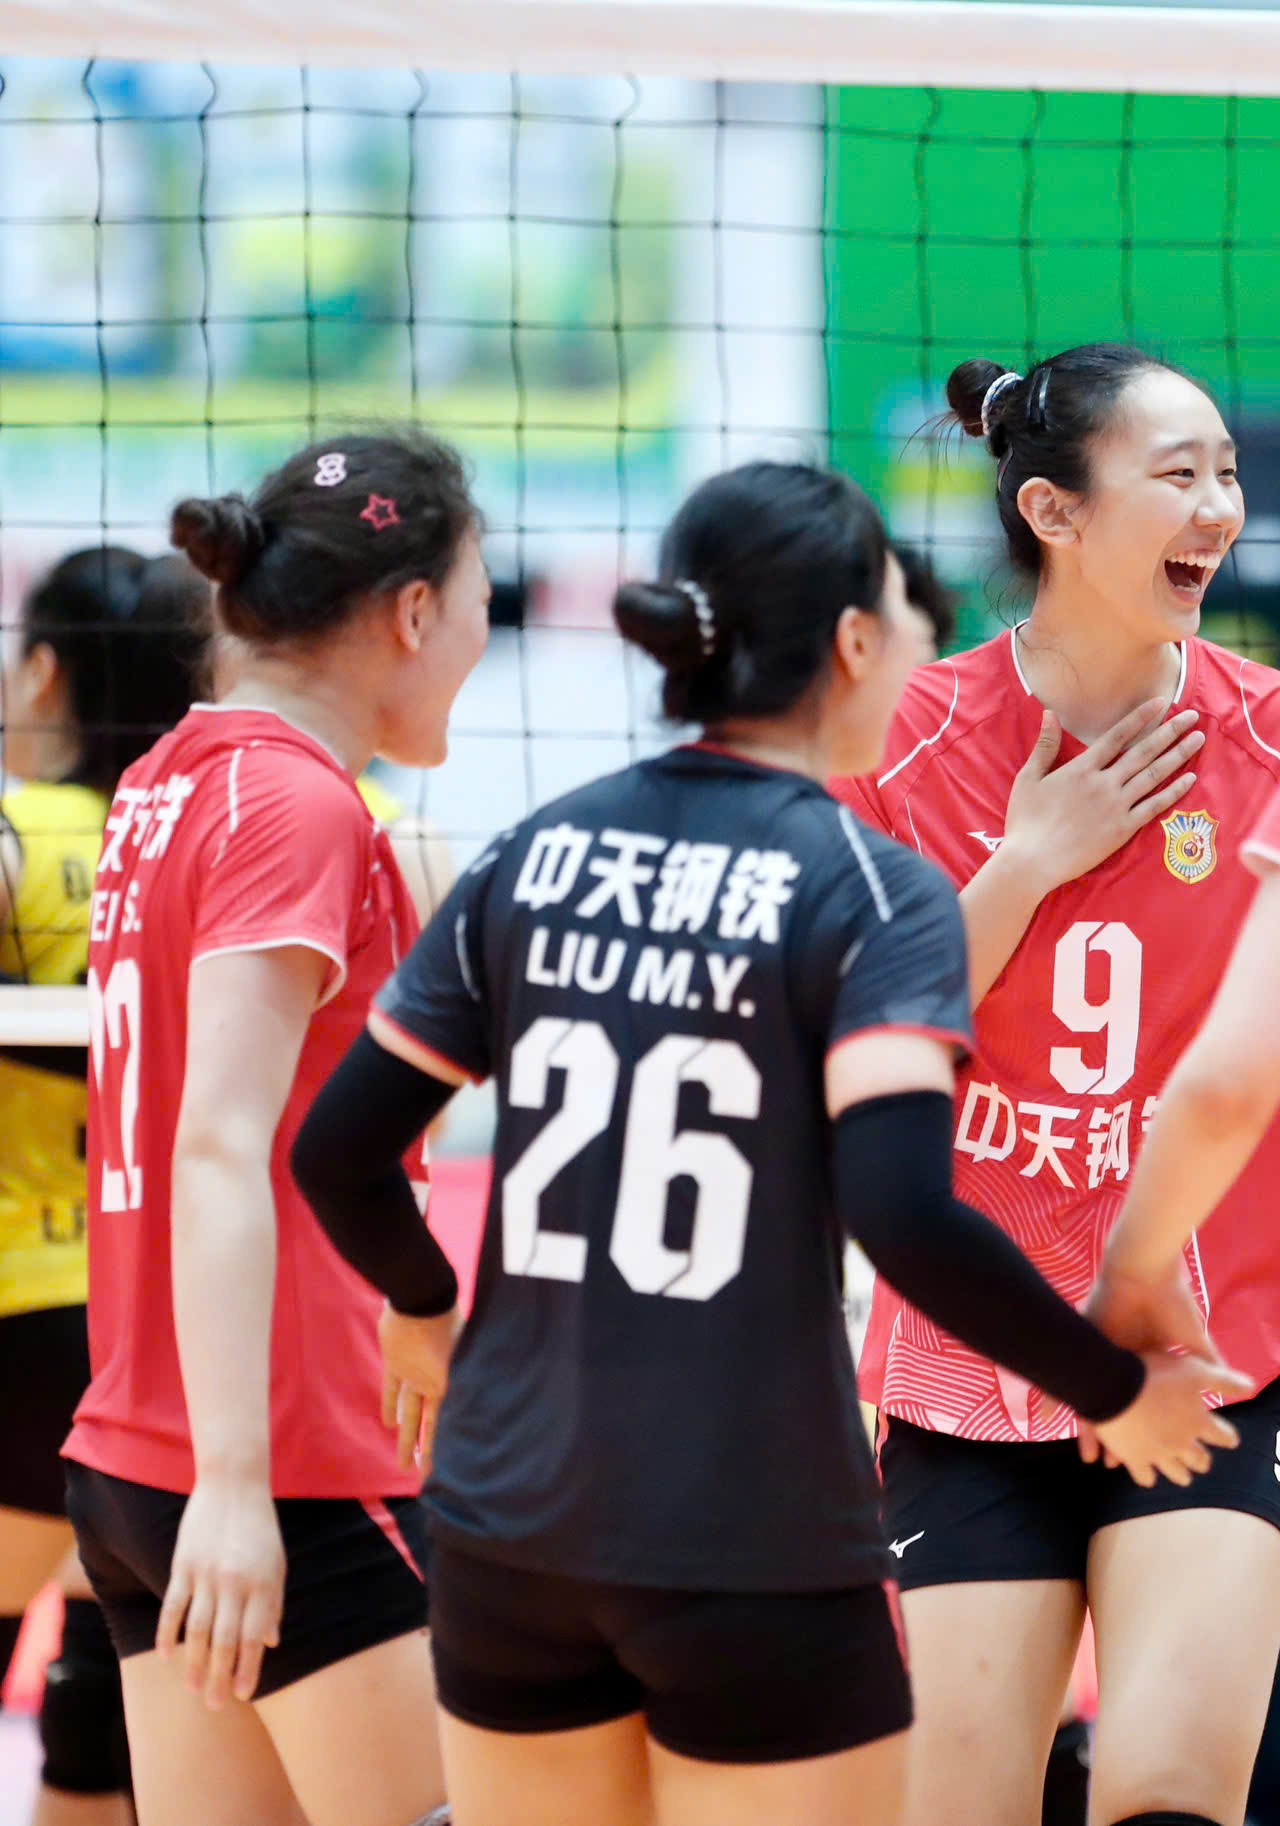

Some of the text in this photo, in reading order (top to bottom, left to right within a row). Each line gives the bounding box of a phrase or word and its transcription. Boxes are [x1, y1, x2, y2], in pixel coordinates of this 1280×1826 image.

[512, 823, 801, 944] 中天钢铁
[525, 927, 756, 1018] LIU M.Y.
[1049, 921, 1142, 1095] 9
[502, 1016, 762, 1302] 26
[953, 1080, 1162, 1190] 中天钢
